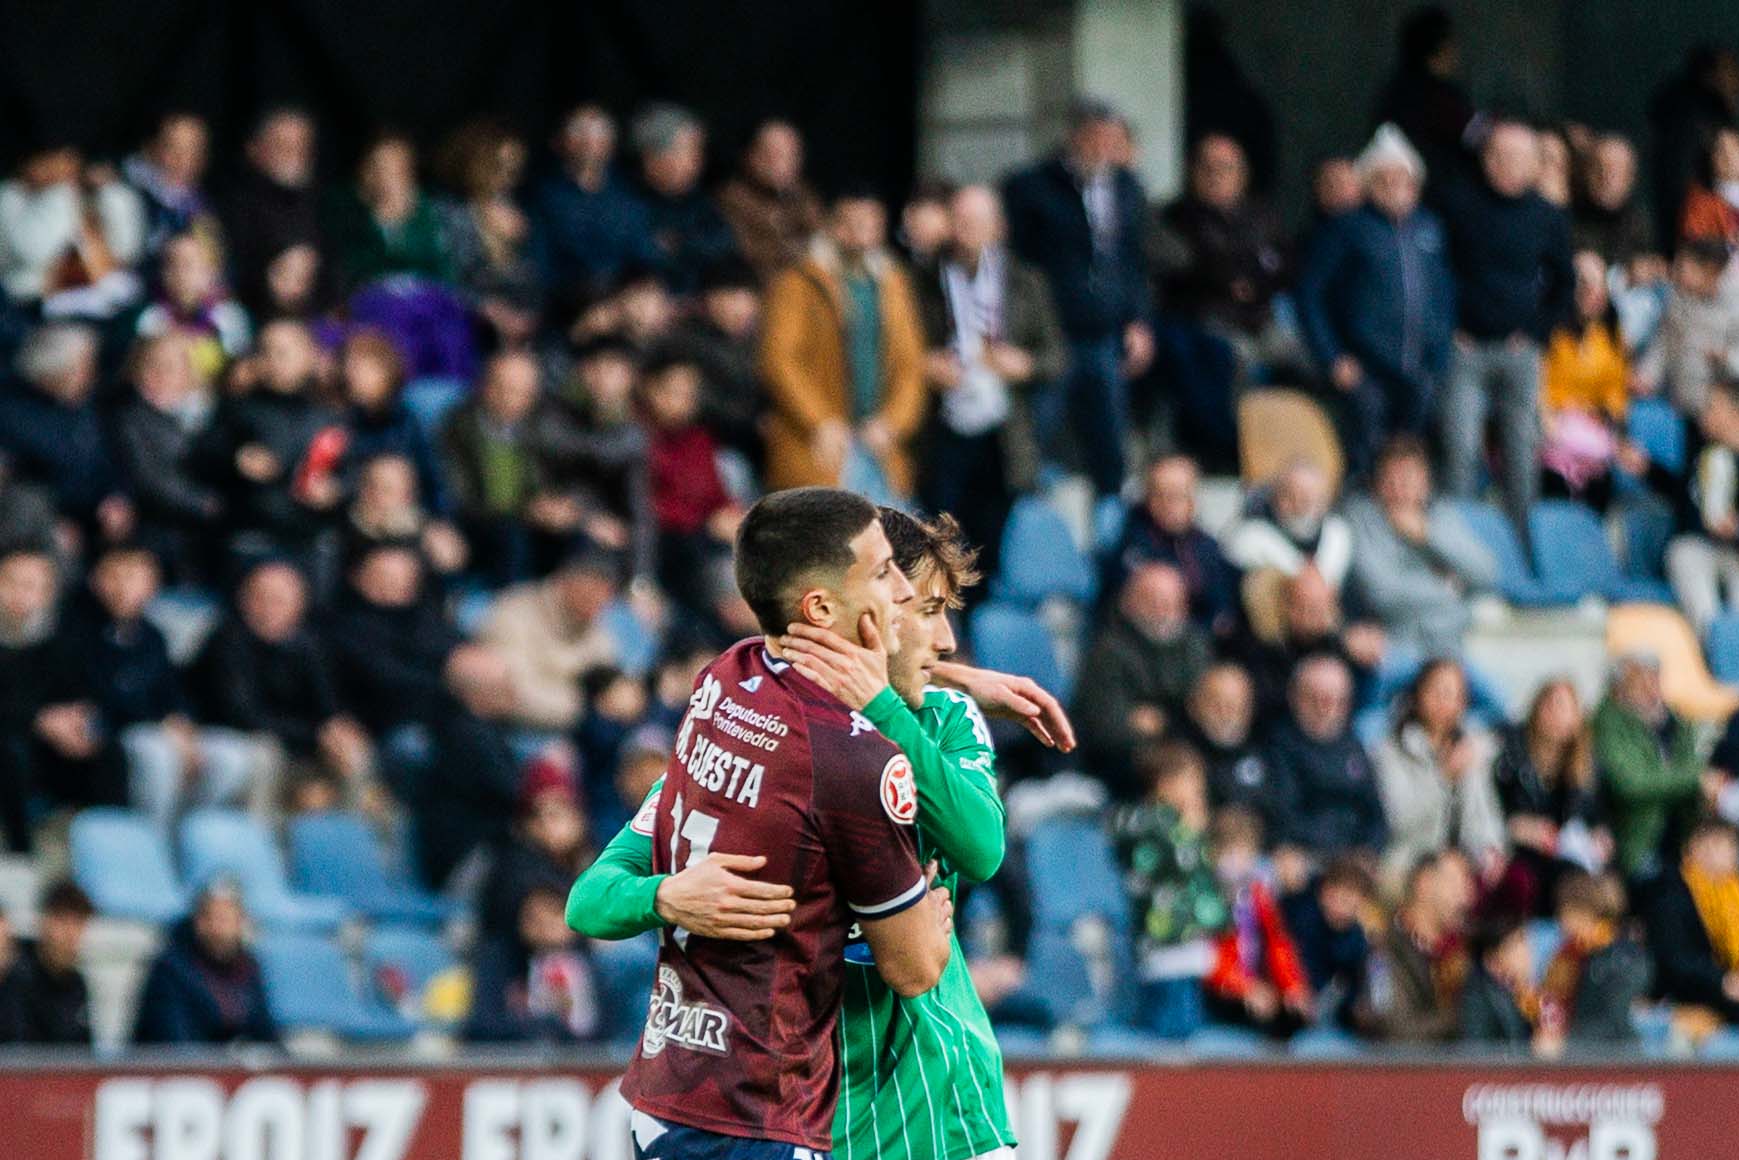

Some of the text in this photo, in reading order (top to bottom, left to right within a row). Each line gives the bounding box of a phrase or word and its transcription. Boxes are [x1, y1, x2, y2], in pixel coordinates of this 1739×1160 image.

[713, 712, 779, 752] Pontevedra
[719, 697, 788, 737] Deputación
[687, 734, 766, 808] CUESTA
